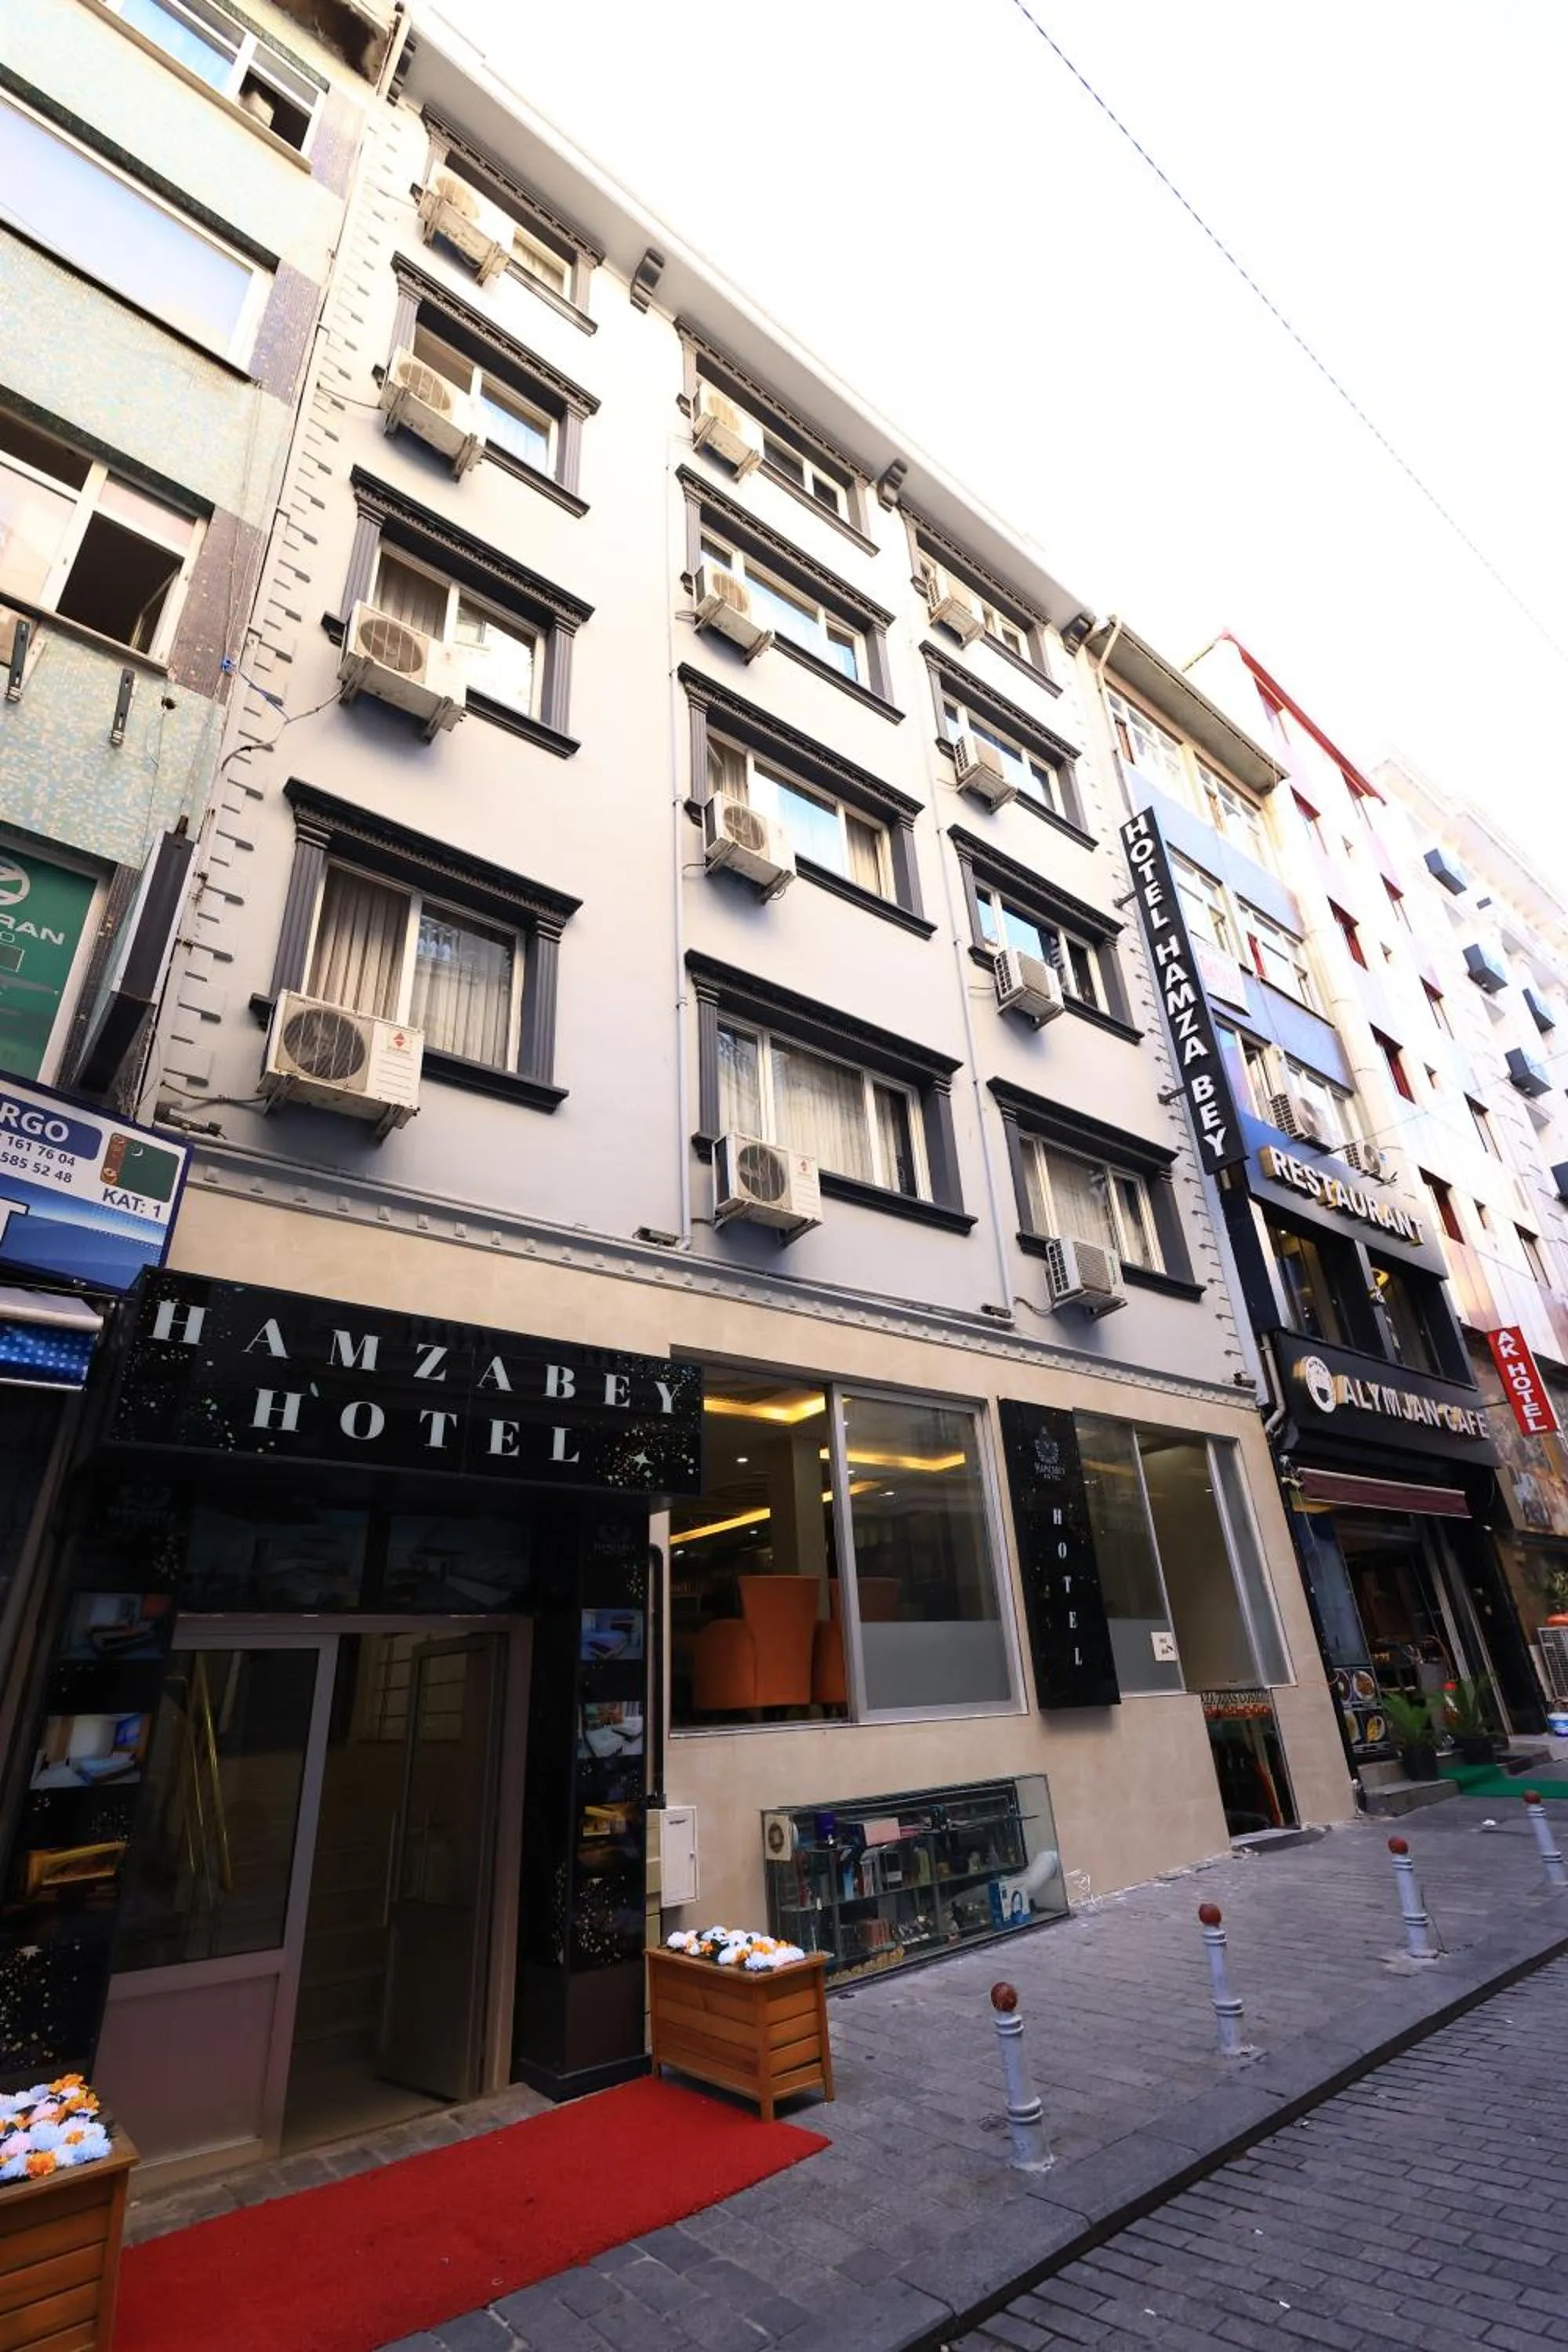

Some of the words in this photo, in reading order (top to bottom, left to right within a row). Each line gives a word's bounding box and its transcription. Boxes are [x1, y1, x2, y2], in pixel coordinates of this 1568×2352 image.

[1125, 814, 1167, 930] HOTEL
[1156, 936, 1209, 1066] HAMZA
[1191, 1074, 1229, 1160] BEY
[0, 1102, 69, 1142] RGO
[0, 1152, 28, 1169] 585
[32, 1163, 51, 1177] 52
[54, 1171, 72, 1183] 48
[7, 1136, 32, 1152] 161
[38, 1145, 55, 1160] 76
[58, 1152, 76, 1167] 04
[103, 1186, 146, 1214] KAT:
[153, 1203, 162, 1218] 1
[1268, 1146, 1424, 1243] RESTAURANT
[1497, 1330, 1520, 1359] AK
[1506, 1362, 1548, 1432] HOTEL
[249, 1388, 581, 1464] HOTEL
[1443, 1402, 1490, 1439] CAFE
[1052, 1507, 1083, 1667] HOTEL
